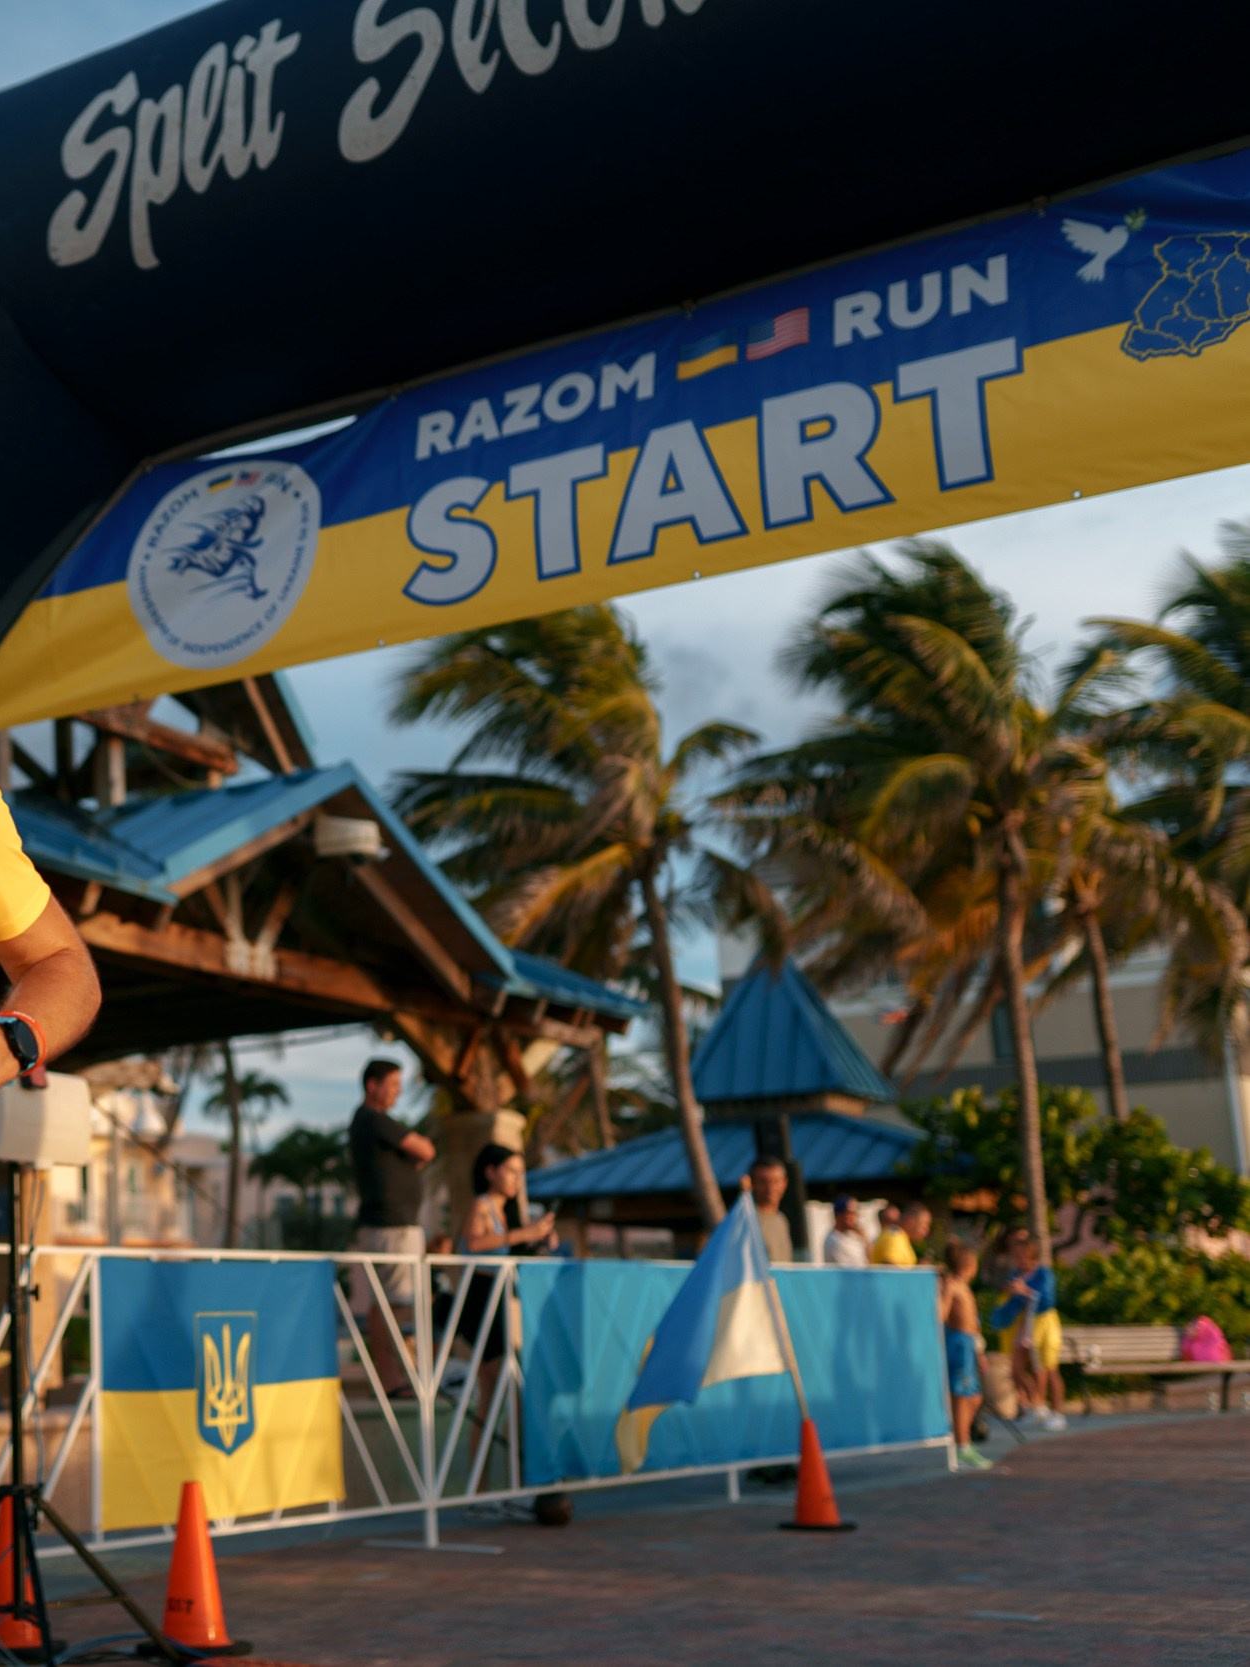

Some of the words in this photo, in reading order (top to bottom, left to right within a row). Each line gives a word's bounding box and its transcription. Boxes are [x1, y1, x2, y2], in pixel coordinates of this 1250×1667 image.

[47, 18, 301, 269] Split
[403, 336, 1024, 606] START
[414, 351, 656, 461] RAZOM
[832, 253, 1009, 347] RUN
